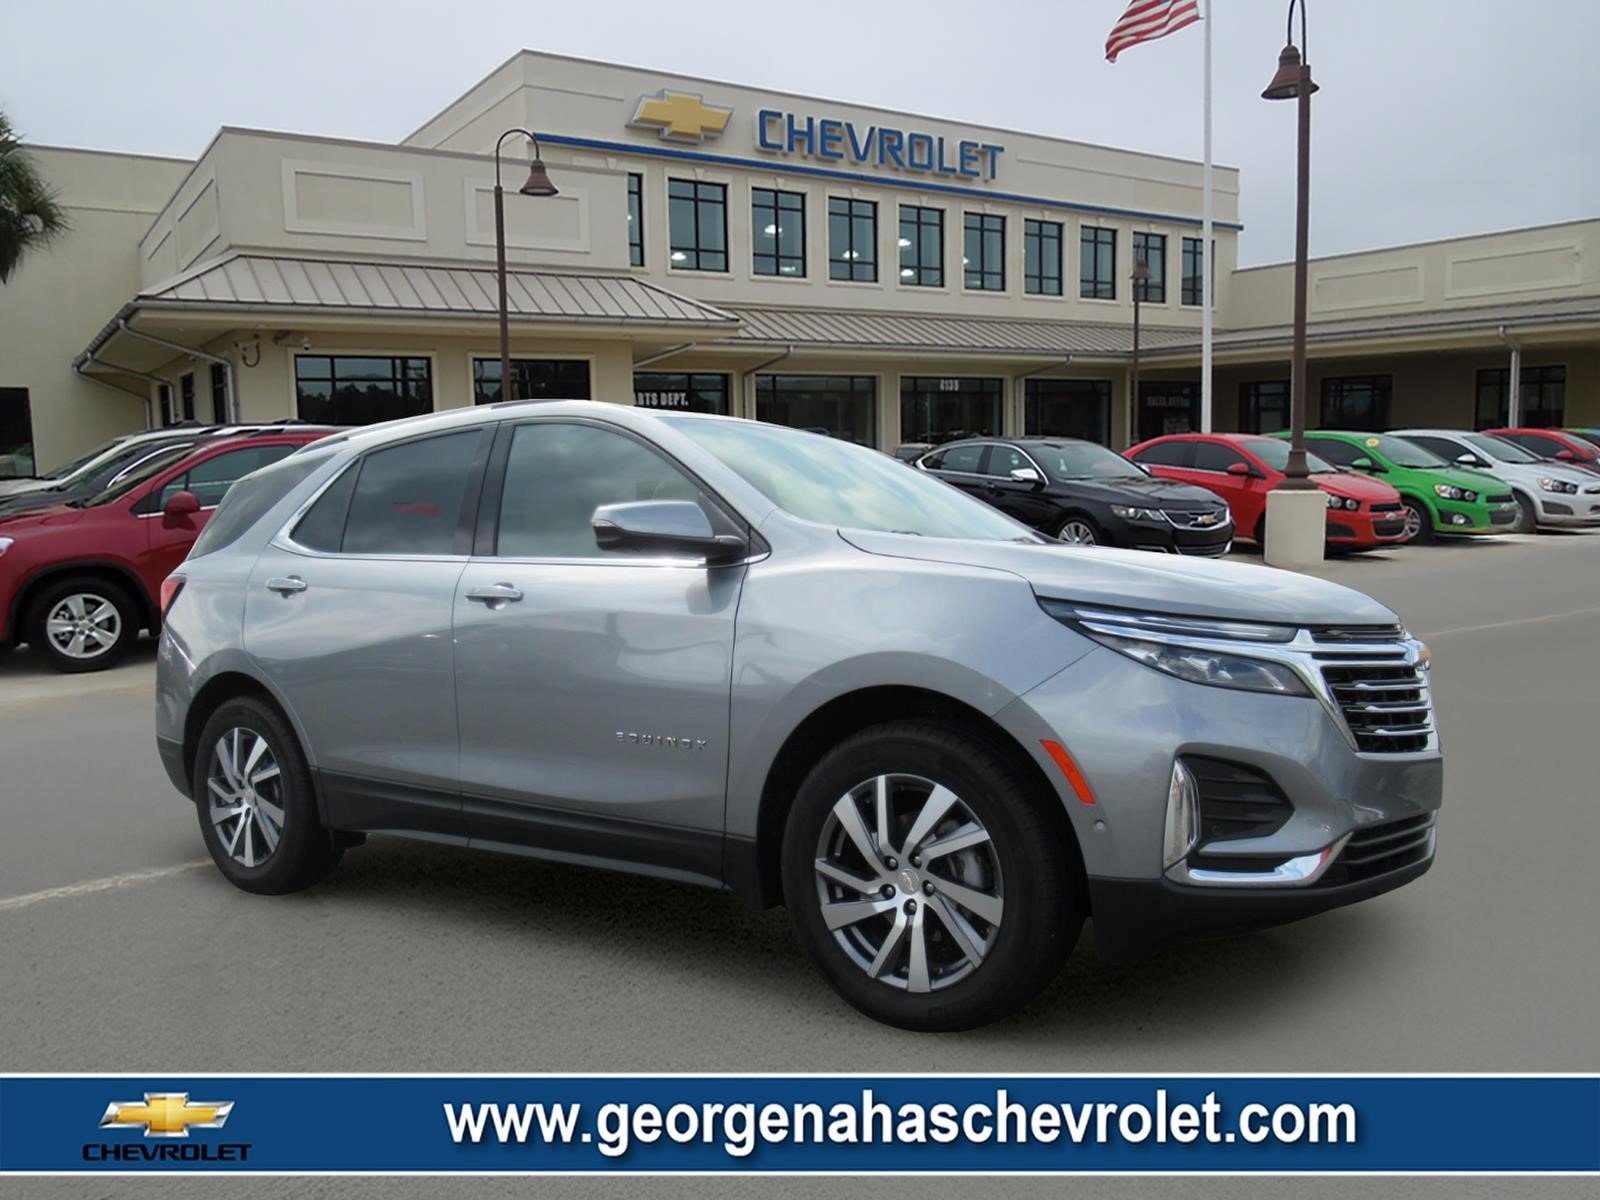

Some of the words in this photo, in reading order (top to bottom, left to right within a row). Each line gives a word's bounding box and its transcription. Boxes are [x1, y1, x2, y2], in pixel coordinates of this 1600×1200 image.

[757, 108, 1005, 181] CHEVROLET
[660, 391, 689, 406] DEPT.
[616, 731, 707, 750] EQUINOX
